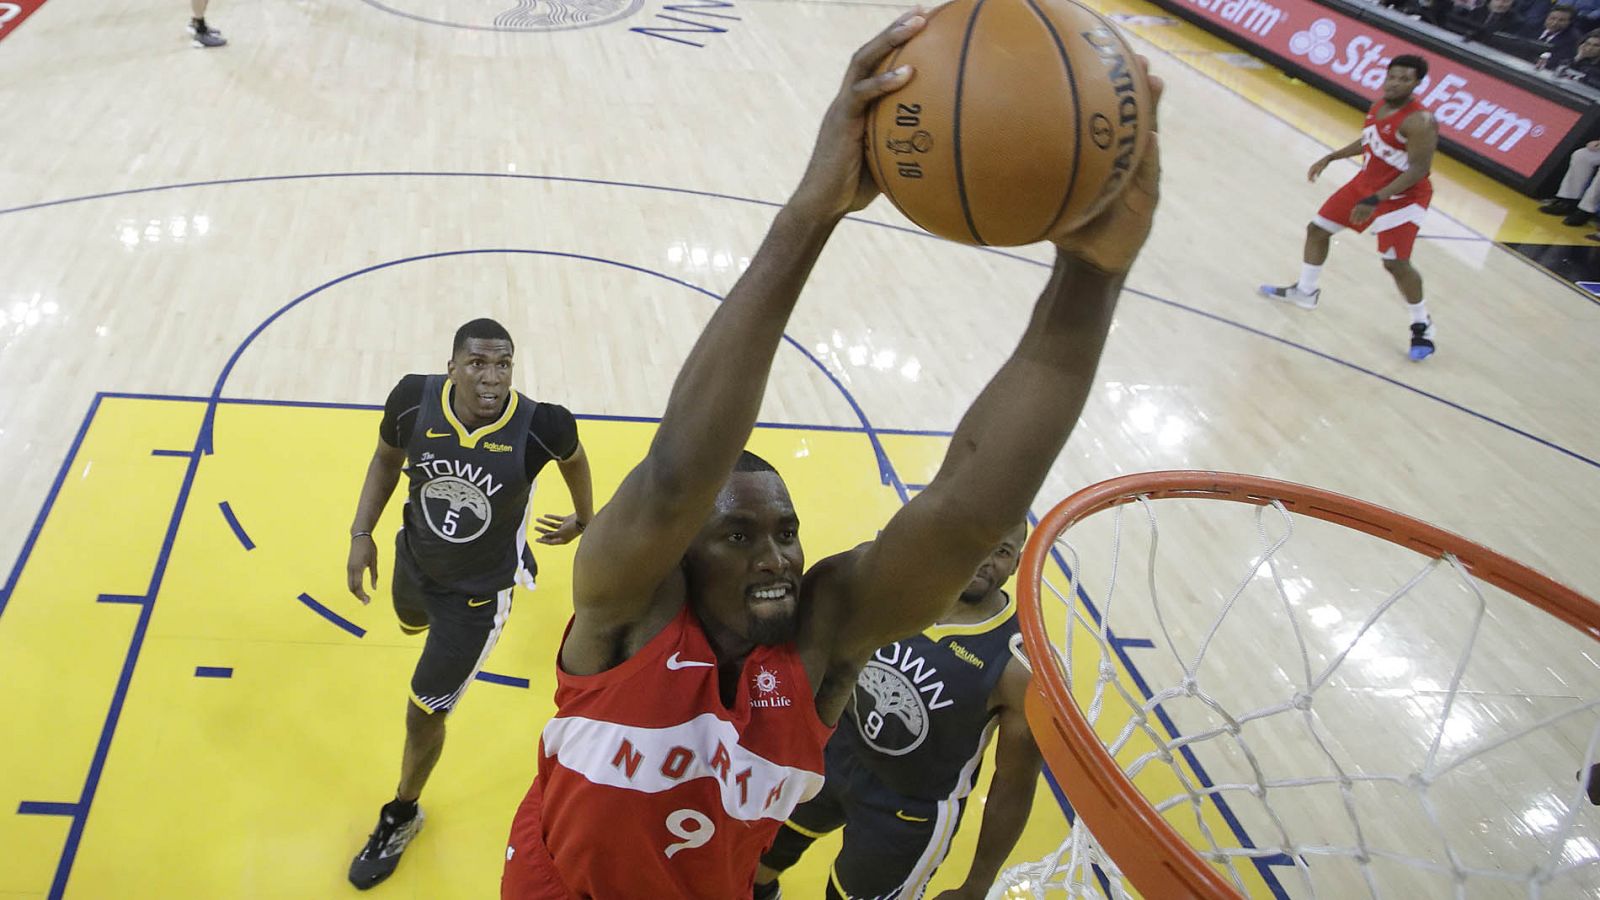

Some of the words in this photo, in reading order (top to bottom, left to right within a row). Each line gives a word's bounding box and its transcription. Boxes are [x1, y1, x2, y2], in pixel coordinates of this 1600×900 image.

[1331, 35, 1431, 95] Sta
[1420, 74, 1534, 153] Farm
[896, 103, 922, 127] 20
[421, 451, 435, 461] The
[483, 441, 513, 453] Rakuten
[416, 459, 503, 497] TOWN
[441, 510, 460, 536] 5
[949, 640, 985, 670] Rakuten
[875, 641, 954, 711] OWN
[770, 696, 791, 707] Life
[864, 710, 884, 740] 9
[611, 737, 787, 810] NORTH
[664, 808, 716, 859] 9
